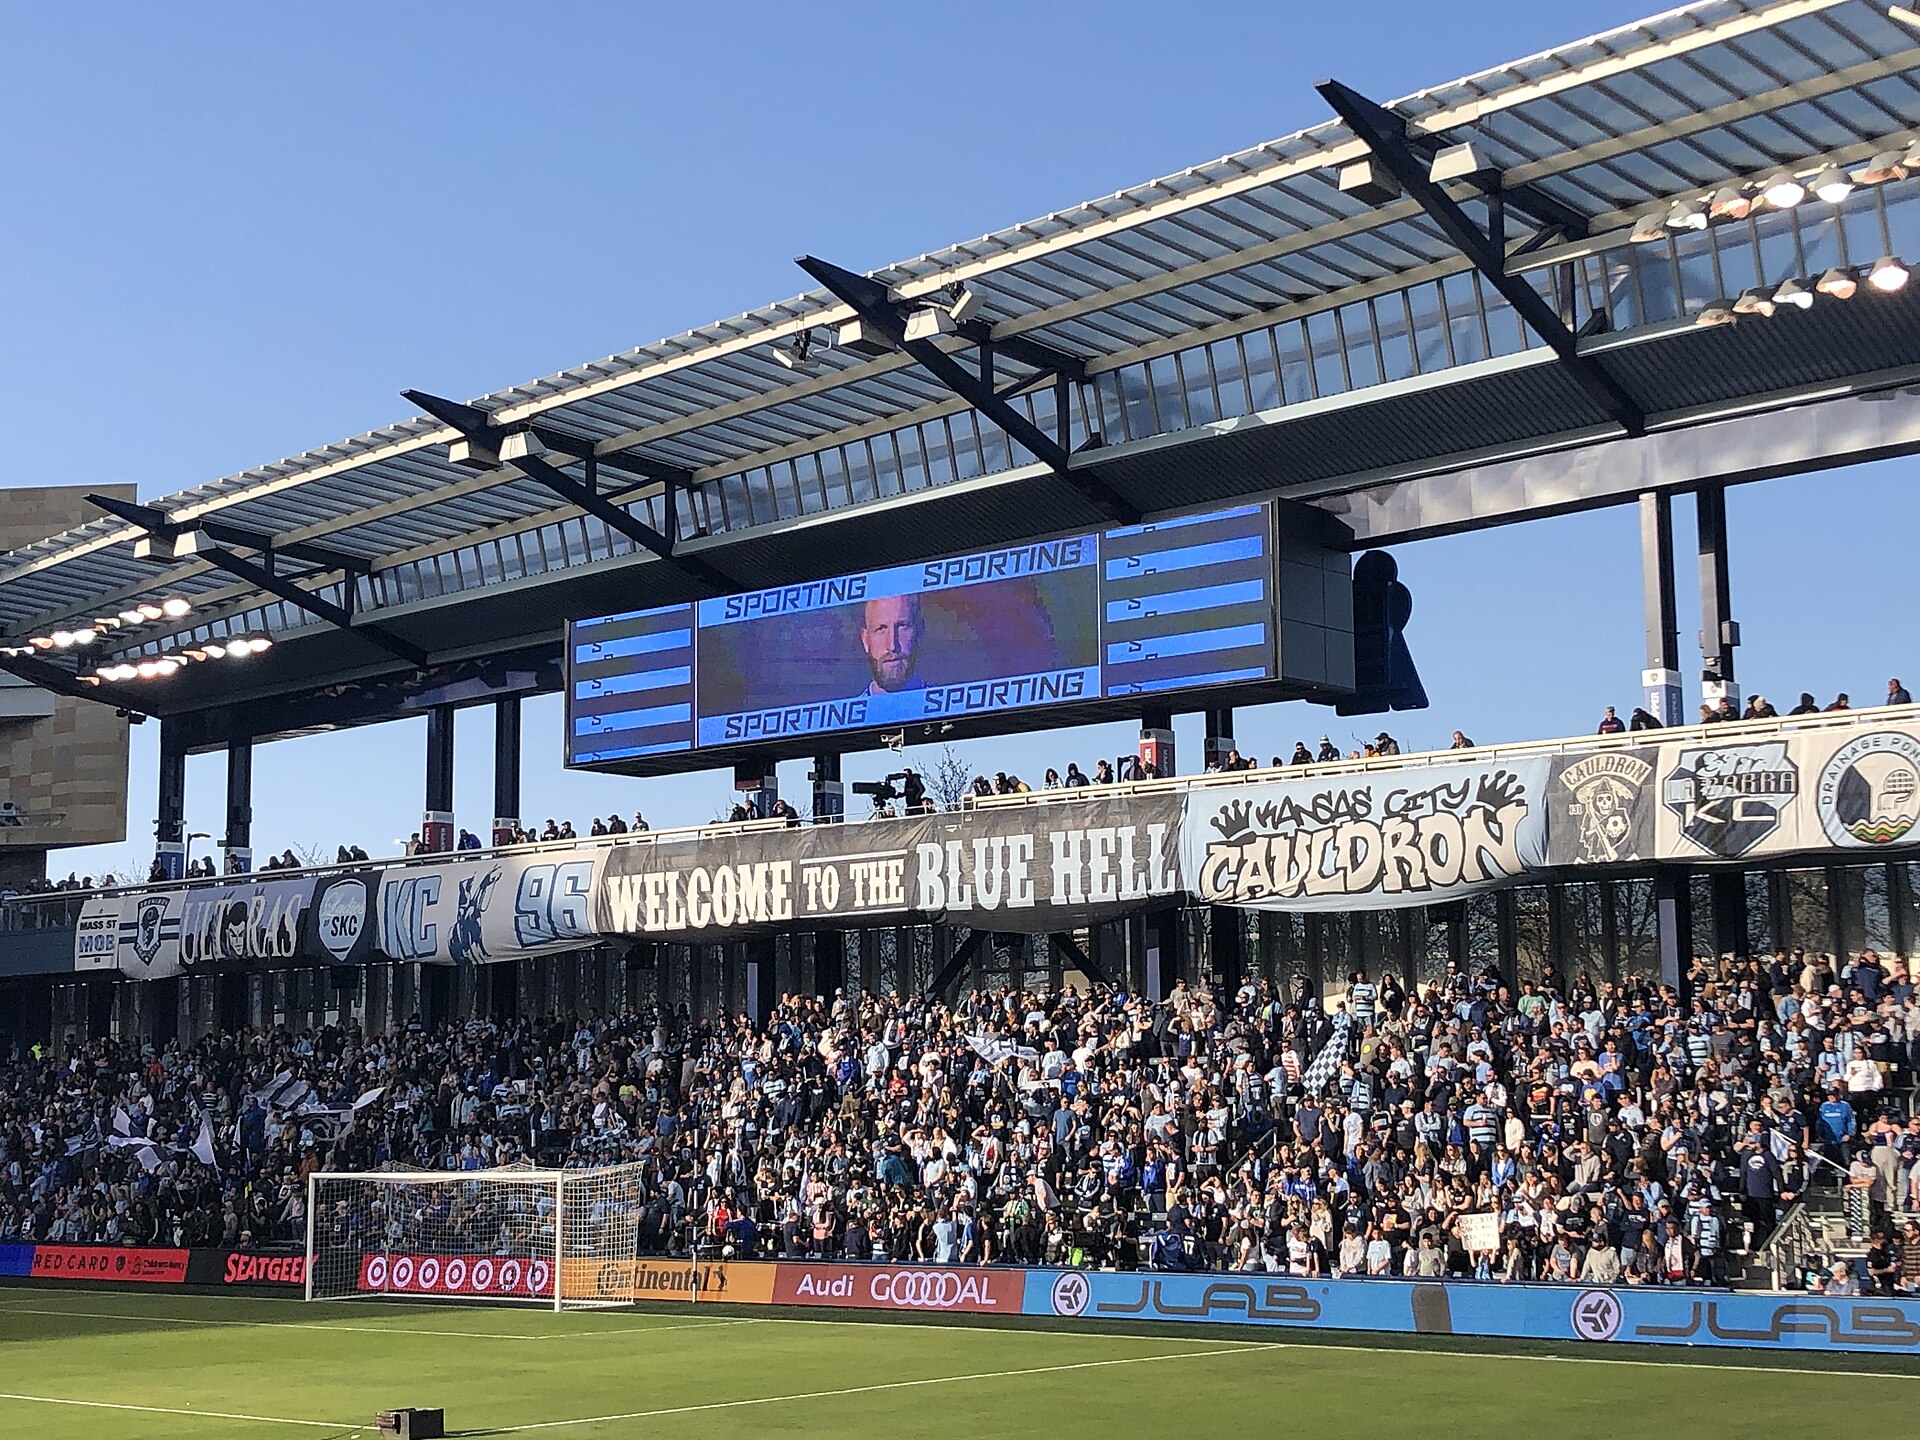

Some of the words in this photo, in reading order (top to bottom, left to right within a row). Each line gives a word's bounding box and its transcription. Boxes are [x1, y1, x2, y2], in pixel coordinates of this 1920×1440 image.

[922, 539, 1083, 587] SPORTING
[725, 576, 867, 619] SPORTING
[923, 670, 1084, 714] SPORTING
[725, 699, 868, 739] SPORTING
[1564, 756, 1649, 786] CAULDRON
[1822, 737, 1882, 805] DRAINAGE
[1890, 737, 1920, 767] POM
[1255, 786, 1372, 829] KANSAS
[1384, 778, 1470, 817] CITY
[1199, 804, 1528, 904] CAULDRON
[607, 860, 793, 934] WELCOME
[802, 864, 841, 911] TO
[850, 858, 905, 908] THE
[916, 833, 1036, 911] BLUE
[1049, 823, 1176, 906] HELL
[80, 920, 104, 931] MASS
[106, 919, 117, 929] ST
[331, 915, 358, 937] SKC
[384, 875, 442, 960] KC
[514, 861, 595, 948] 96
[80, 934, 115, 953] MOB
[33, 1253, 62, 1269] RED
[67, 1254, 109, 1271] CARD
[796, 1273, 855, 1297] Audi
[1097, 1280, 1322, 1321] JLAB
